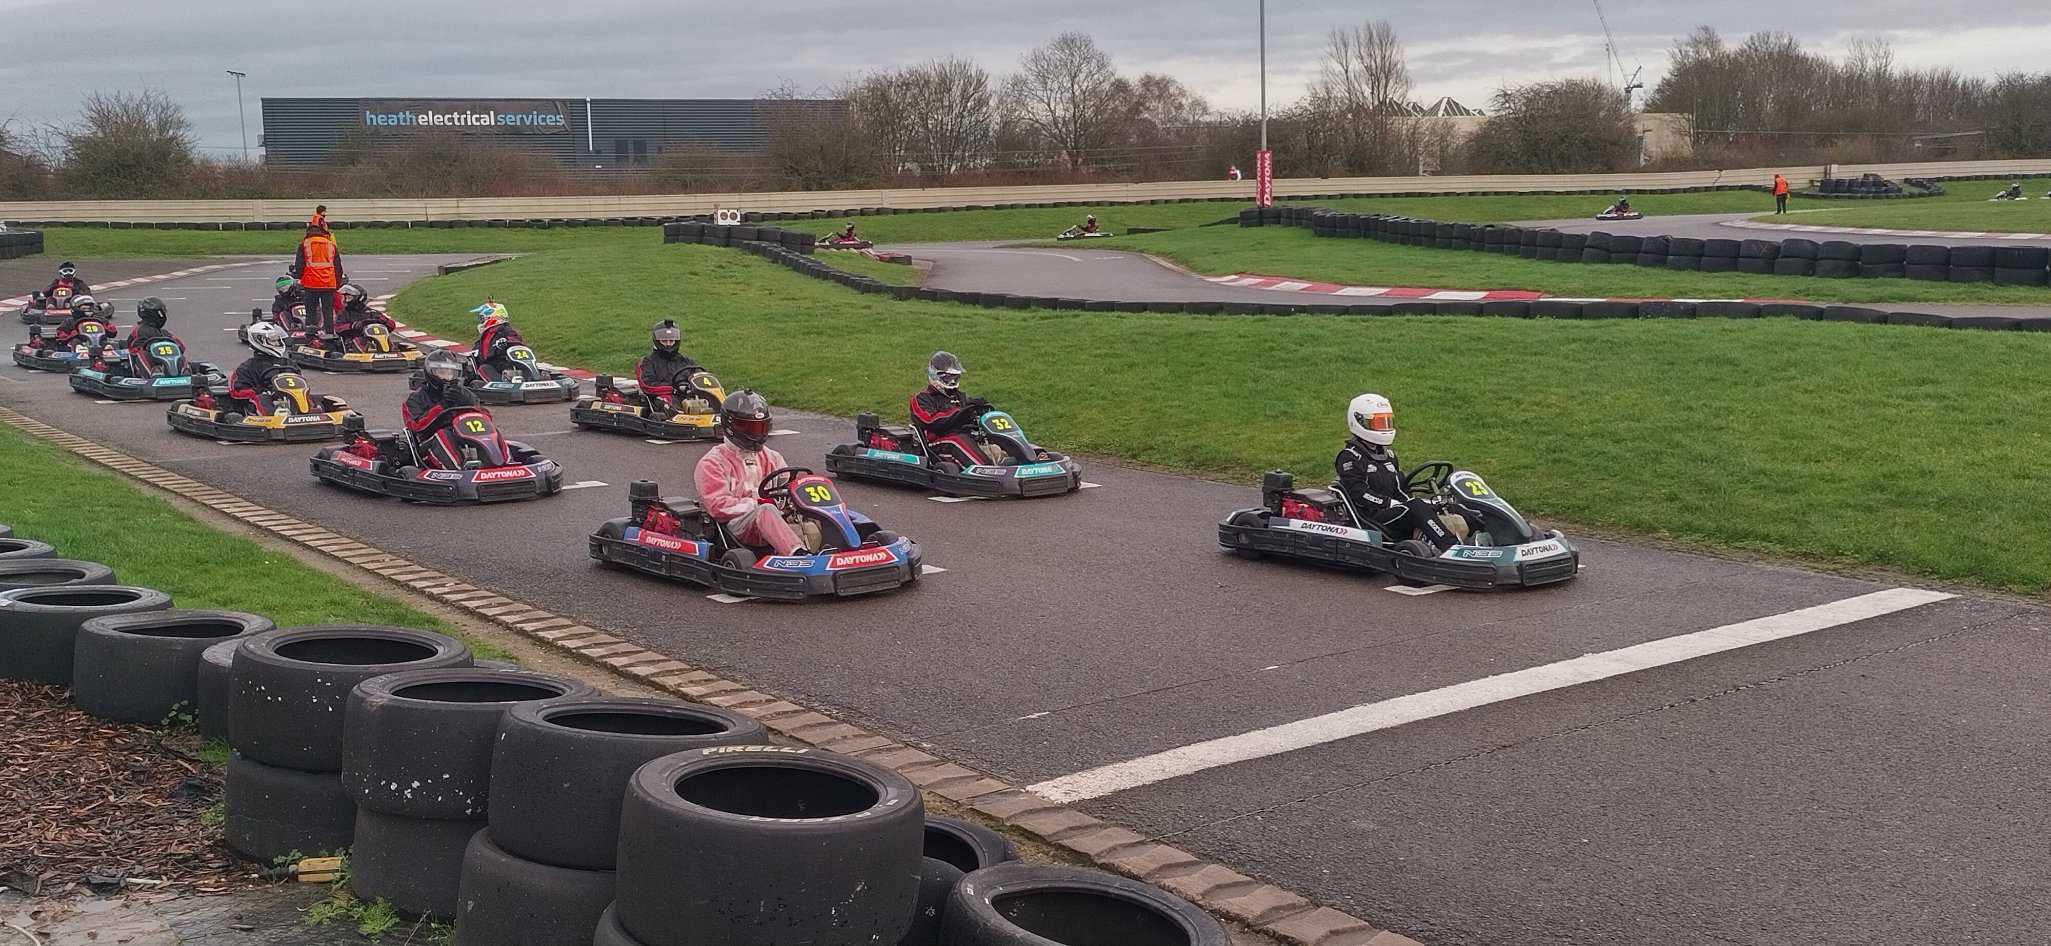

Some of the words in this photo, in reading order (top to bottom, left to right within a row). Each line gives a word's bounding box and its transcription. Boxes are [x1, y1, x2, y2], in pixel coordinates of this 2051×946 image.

[1263, 151, 1272, 207] DAYTONA
[158, 346, 173, 355] 35
[514, 350, 529, 360] 24
[286, 378, 295, 387] 3
[703, 377, 712, 386] 4
[288, 415, 321, 423] DAYTONA
[991, 418, 1012, 430] 32
[465, 420, 486, 433] 12
[480, 470, 518, 480] DAYTONA
[804, 485, 831, 503] 30
[1301, 522, 1340, 534] DAYTONA
[646, 536, 674, 549] DAYTONA
[1521, 544, 1553, 557] DAYTONA
[836, 554, 880, 567] DAYTONA
[702, 745, 809, 755] PIRELLI
